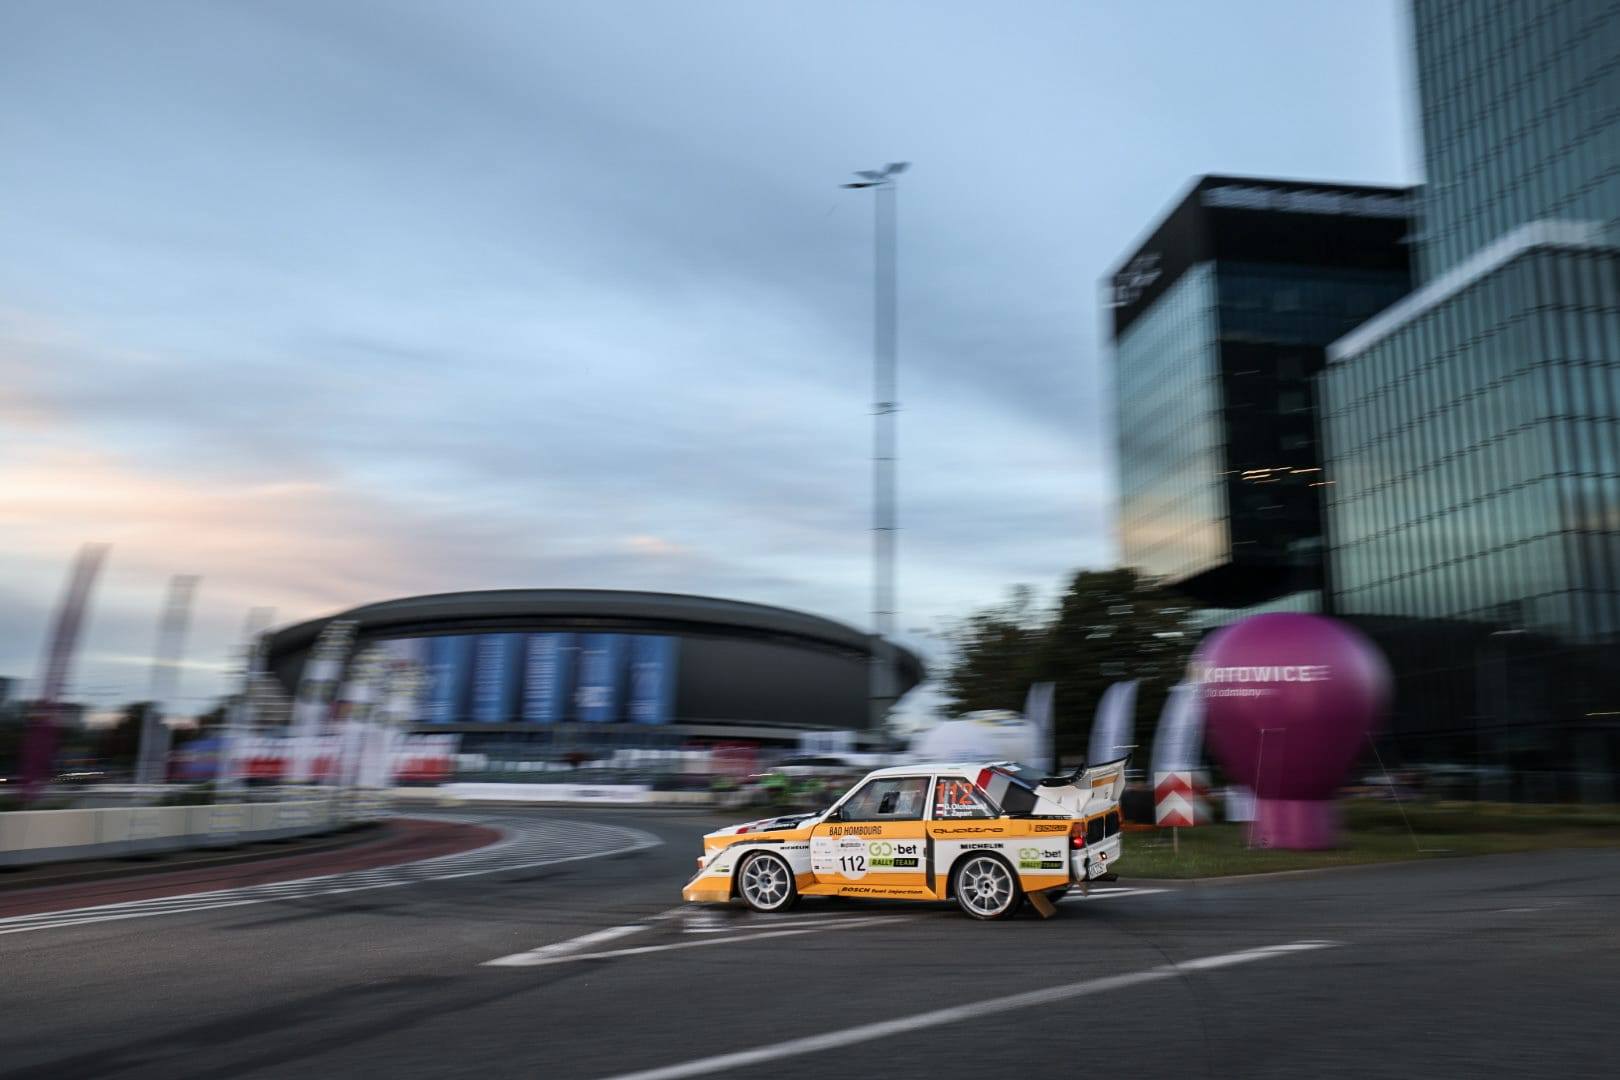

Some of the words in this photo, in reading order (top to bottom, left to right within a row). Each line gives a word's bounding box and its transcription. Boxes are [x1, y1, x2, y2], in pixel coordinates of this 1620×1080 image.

[1203, 665, 1318, 683] KATOWICE
[936, 782, 974, 805] 112
[829, 827, 842, 836] BAD
[843, 825, 883, 835] HOMBOURG
[839, 855, 866, 872] 112
[871, 858, 893, 866] RALLY
[895, 858, 916, 866] TEAM
